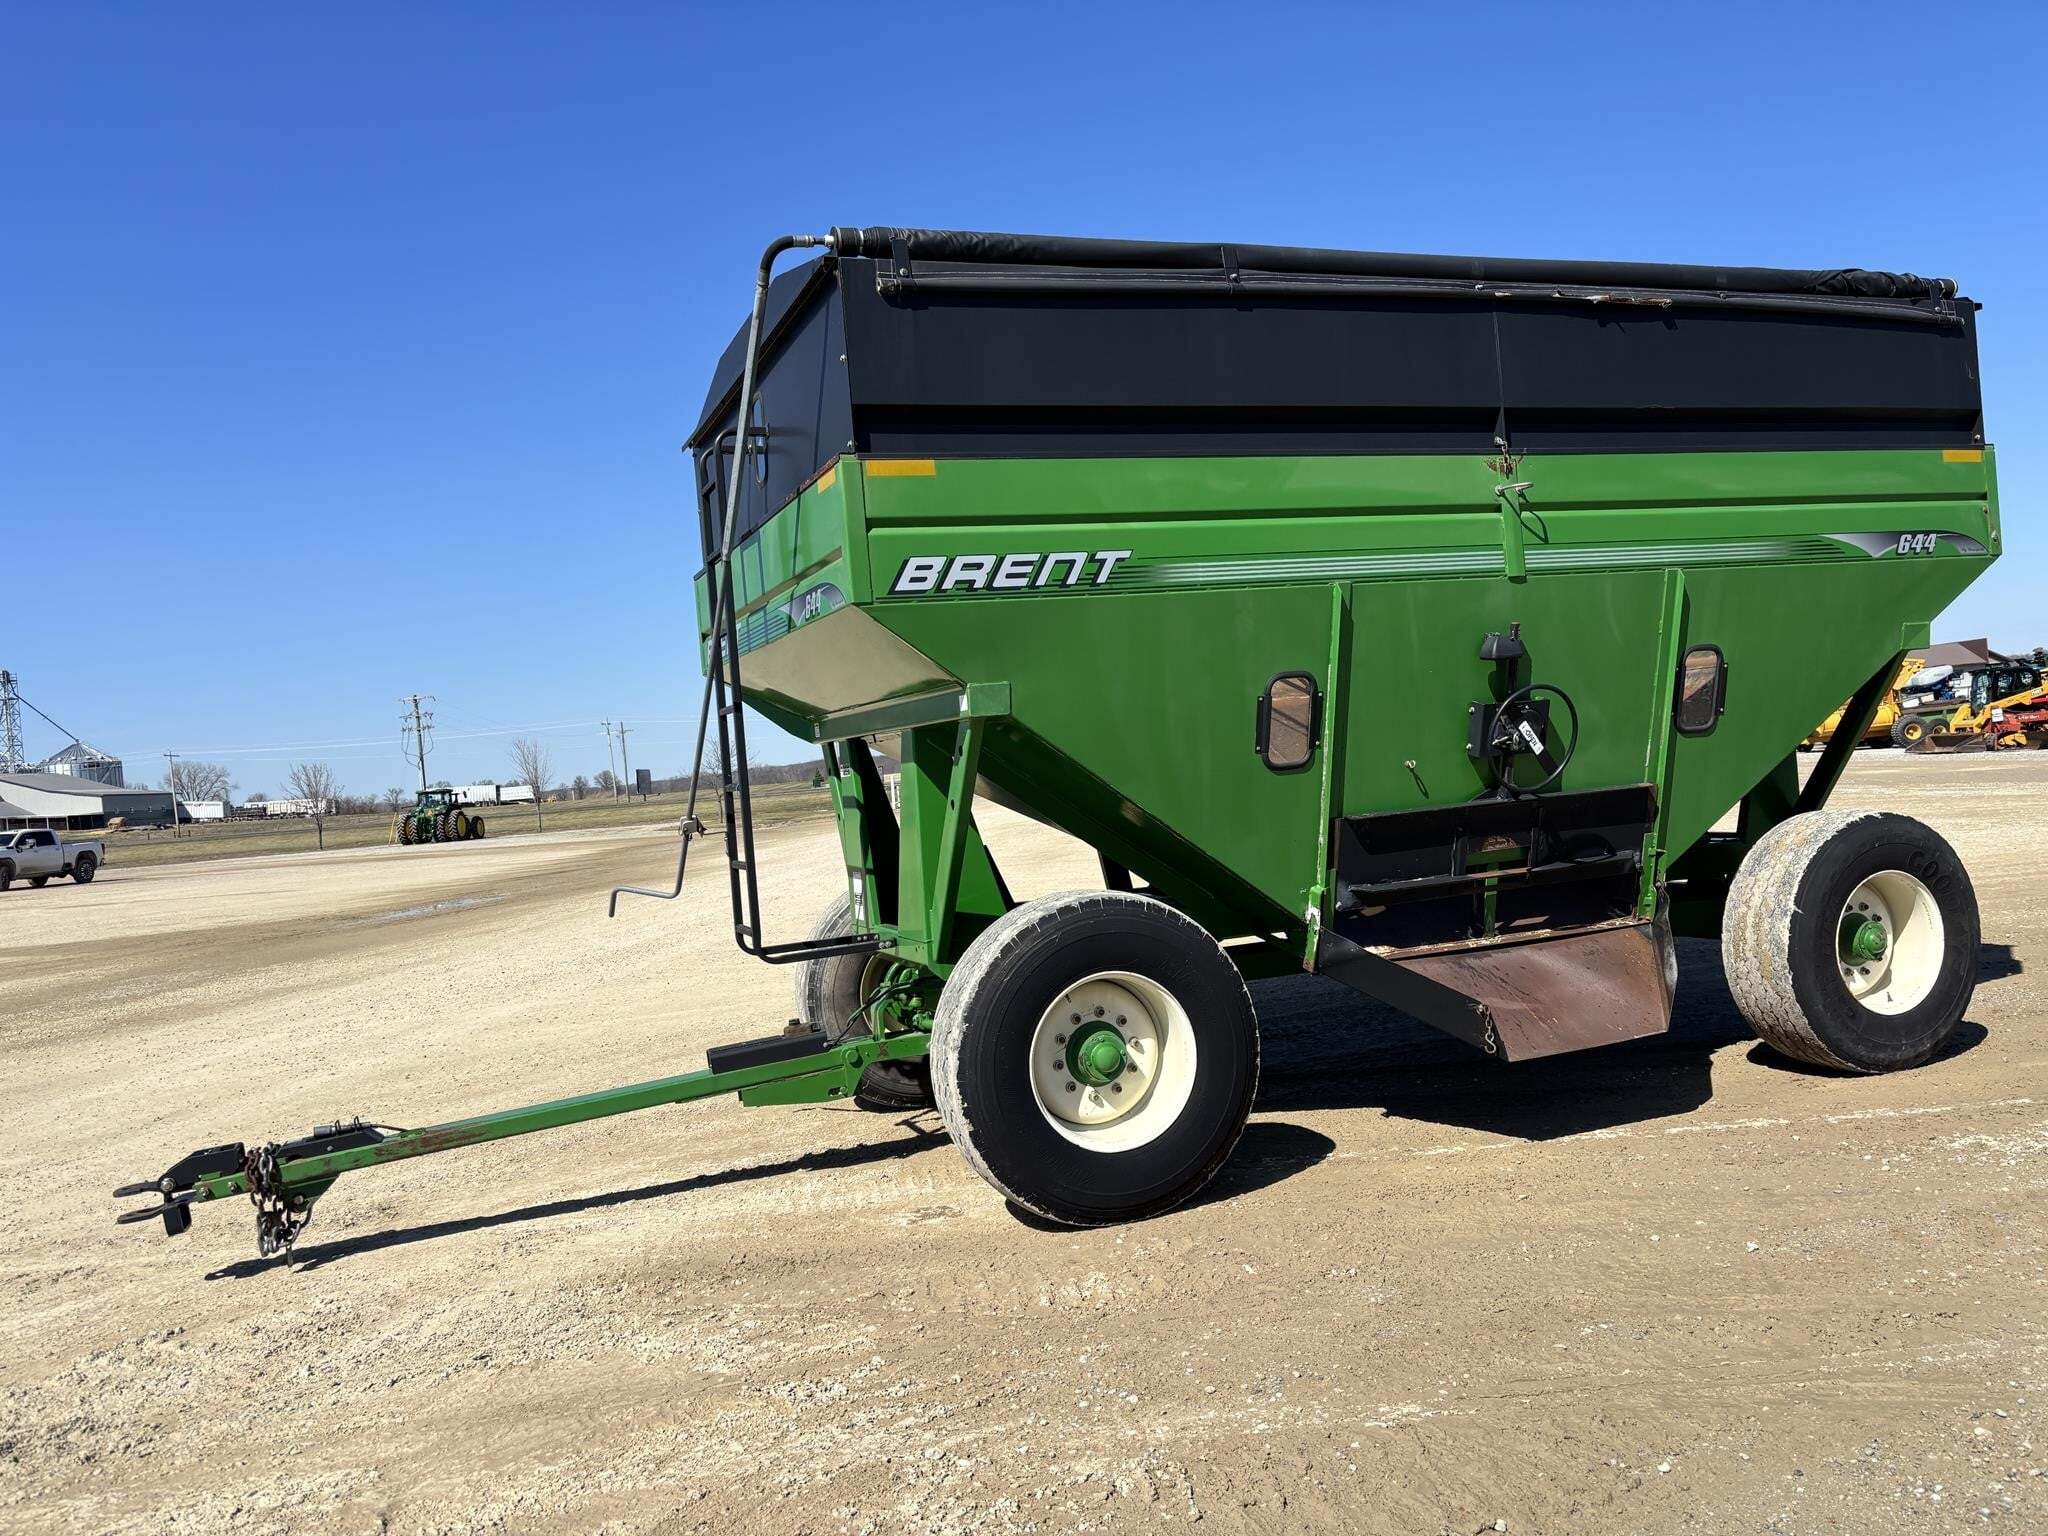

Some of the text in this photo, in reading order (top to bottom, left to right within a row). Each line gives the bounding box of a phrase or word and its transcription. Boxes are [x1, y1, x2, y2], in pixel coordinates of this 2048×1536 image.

[1896, 533, 1937, 556] 644
[888, 549, 1133, 595] BRENT
[805, 589, 821, 619] 644
